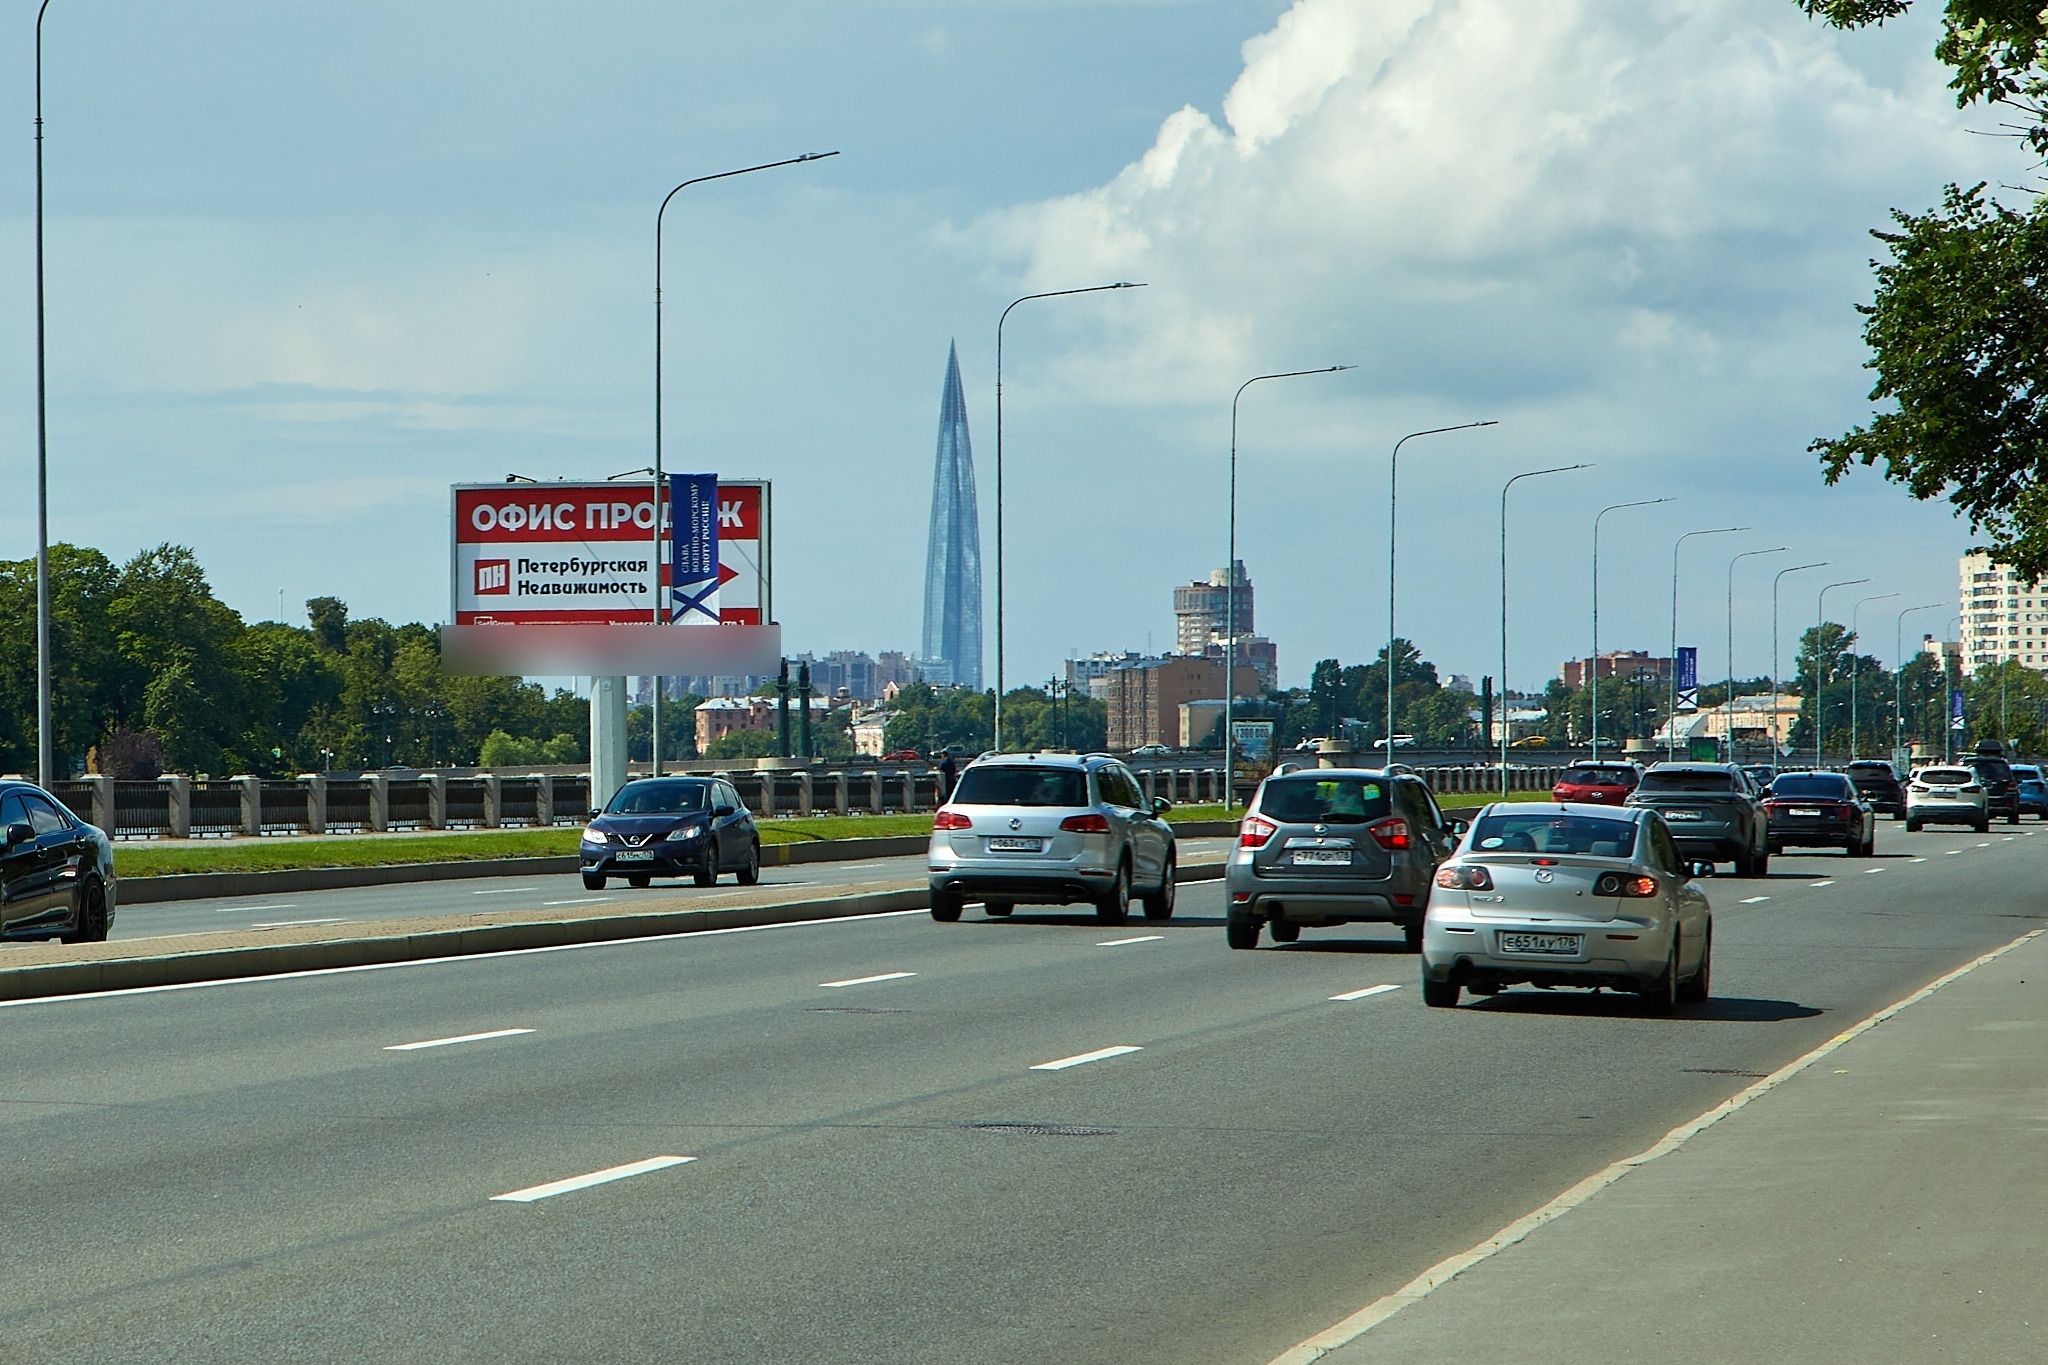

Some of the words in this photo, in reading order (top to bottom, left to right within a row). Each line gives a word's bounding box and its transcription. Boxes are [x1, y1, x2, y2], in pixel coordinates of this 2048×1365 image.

[471, 502, 576, 532] ОФИС
[585, 500, 744, 534] ПРОЖ
[690, 482, 700, 573] ВОЕННО-МОРСКОМУ
[701, 500, 710, 541] РОССИИ!
[517, 557, 648, 576] Петербургская
[681, 543, 690, 574] СЛАВА
[701, 541, 711, 574] ФЛОТУ
[478, 564, 506, 592] ПН
[517, 580, 648, 597] Недвижимость
